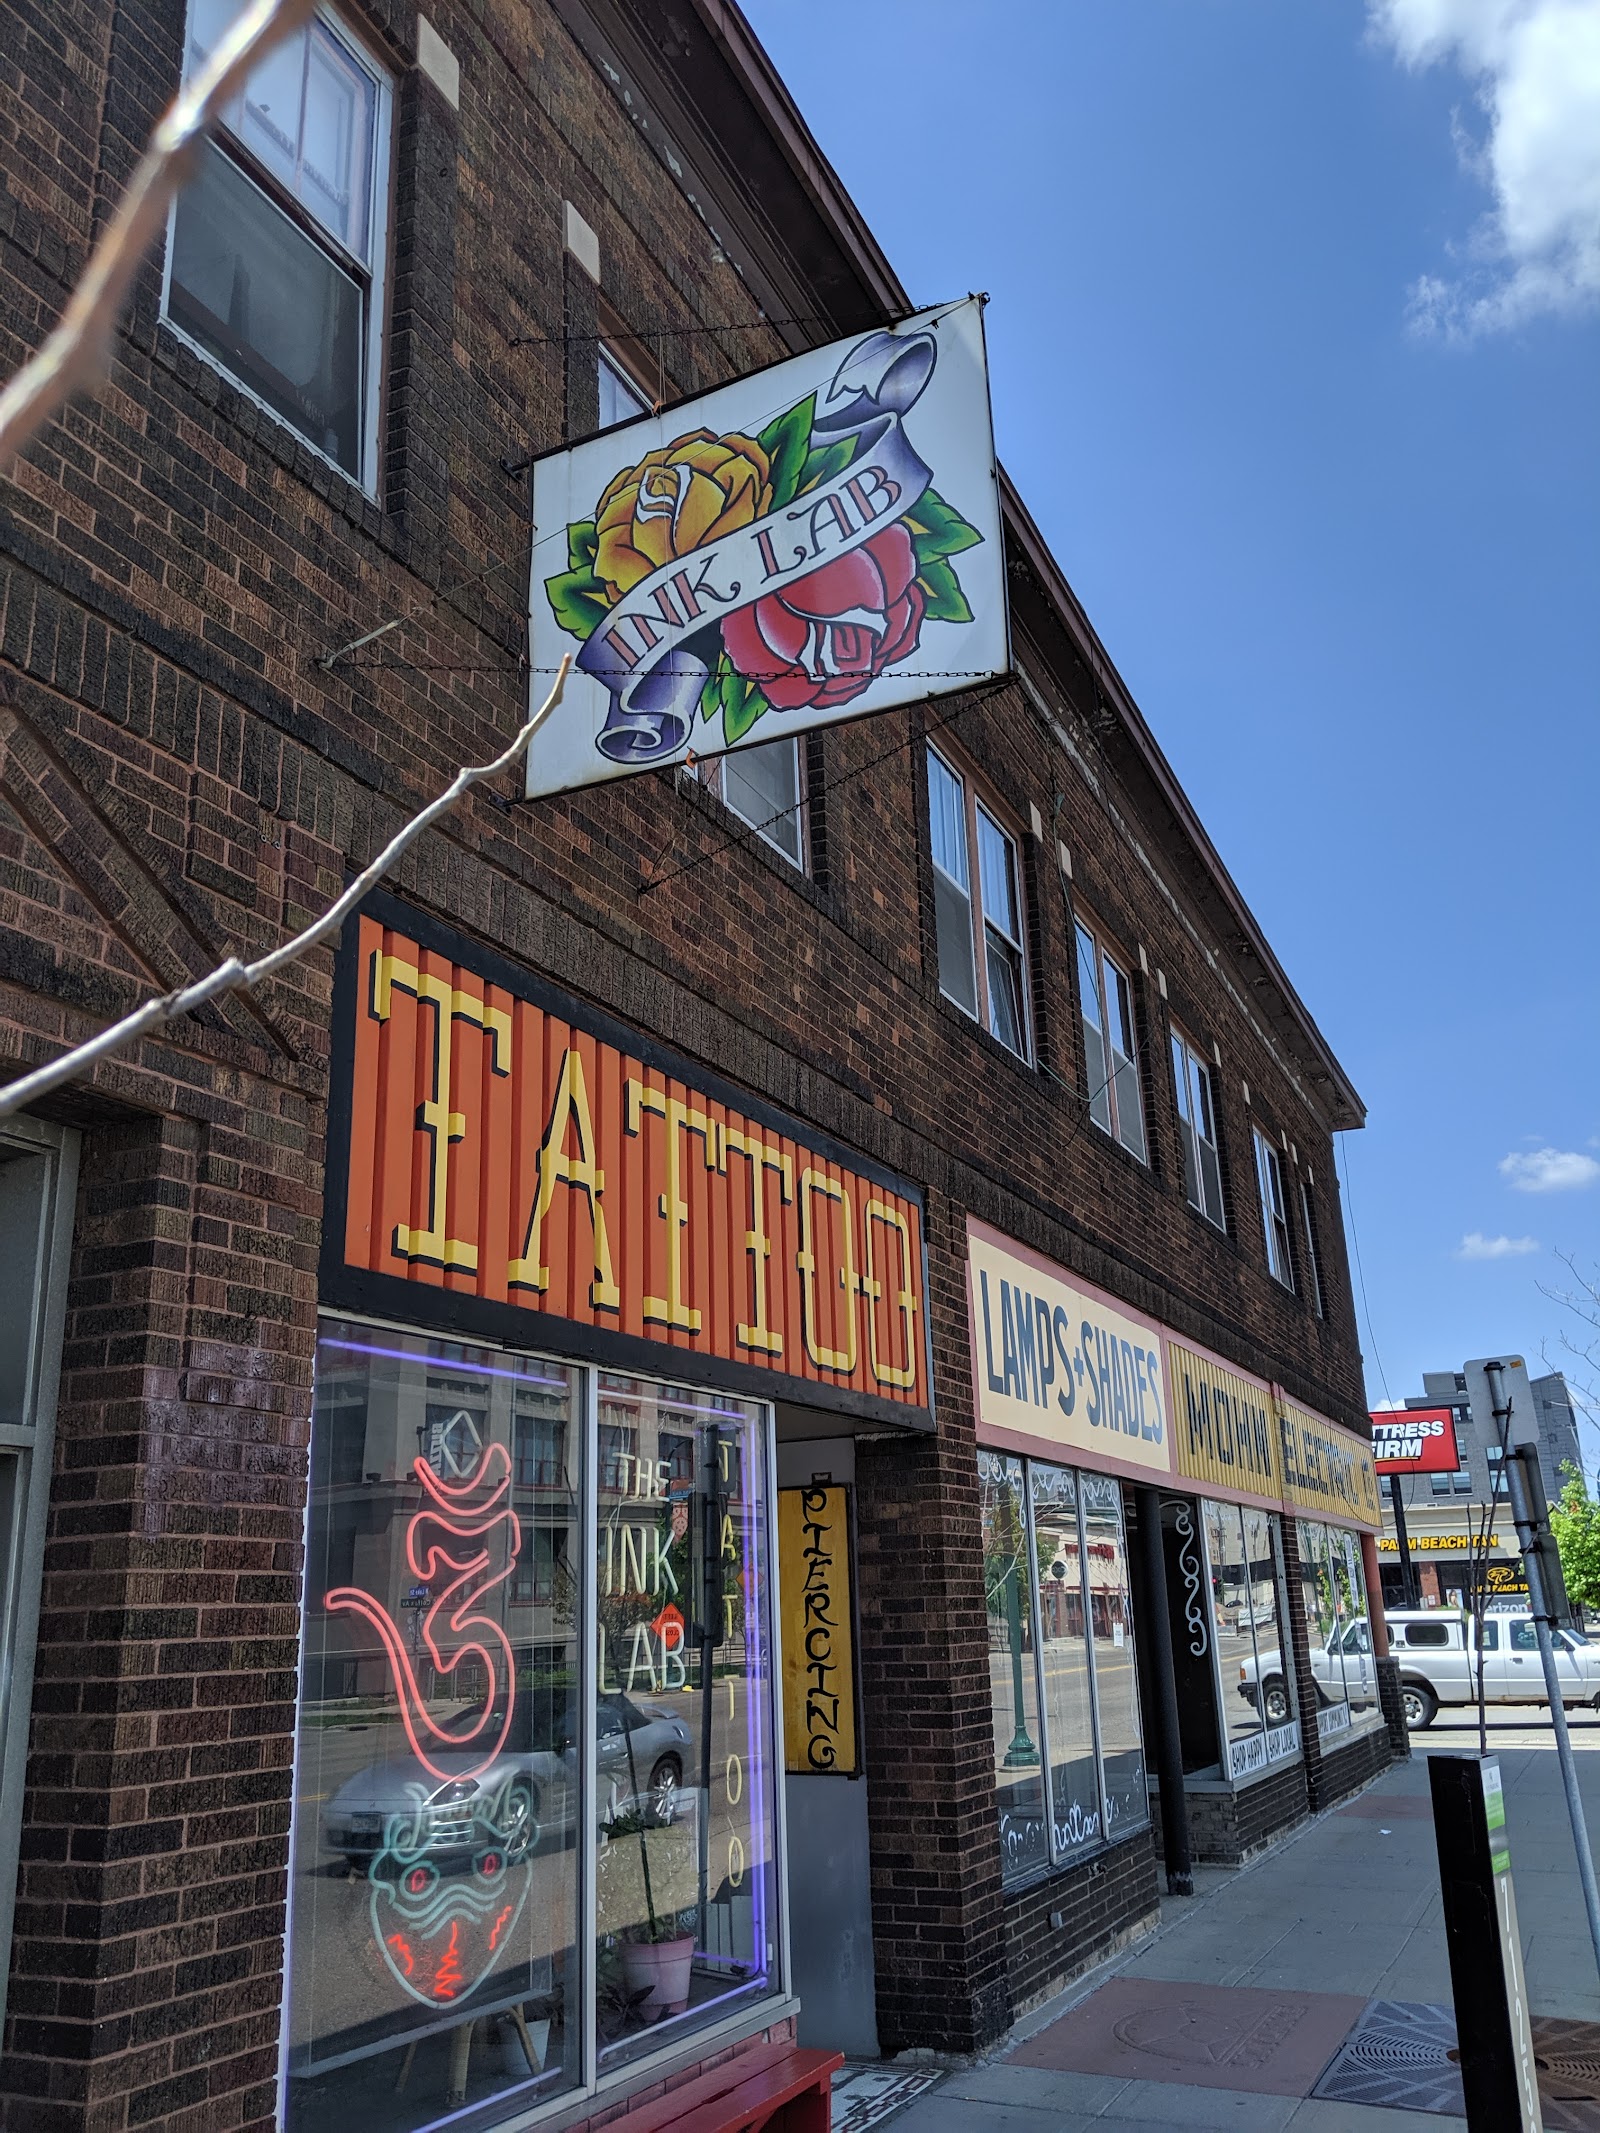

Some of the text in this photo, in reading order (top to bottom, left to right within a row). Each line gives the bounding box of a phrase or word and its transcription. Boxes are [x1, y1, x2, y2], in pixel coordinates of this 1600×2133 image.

[600, 465, 902, 671] INK LAB
[368, 948, 917, 1391] TATTOO
[612, 1452, 672, 1503] THE
[1279, 1416, 1359, 1505] ELECTRIC
[605, 1523, 680, 1598] INK
[1380, 1537, 1418, 1551] PAM
[1421, 1536, 1467, 1550] BEACH
[598, 1620, 687, 1696] LAB
[718, 1439, 745, 1888] TATTOO
[800, 1488, 840, 1770] PIERCING
[1231, 1736, 1264, 1776] SHOP HAPPY
[1280, 1726, 1296, 1754] LOCAL
